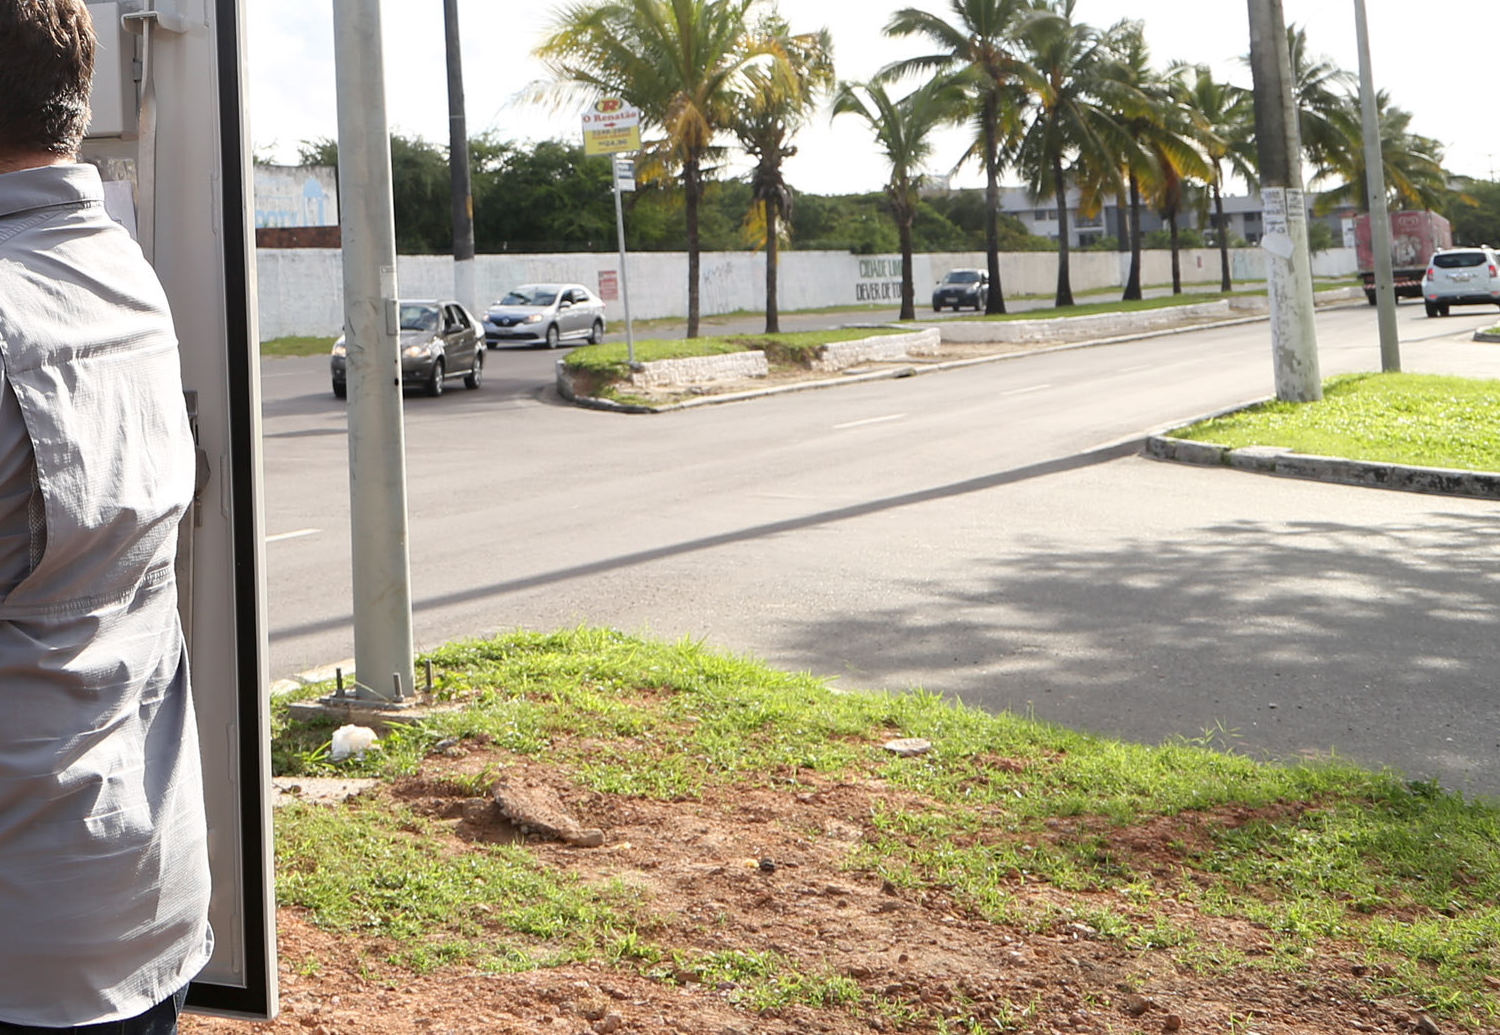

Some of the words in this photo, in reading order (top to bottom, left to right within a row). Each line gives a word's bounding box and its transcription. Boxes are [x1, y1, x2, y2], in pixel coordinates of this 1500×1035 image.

[860, 259, 887, 278] CIDADE
[889, 259, 903, 277] LIM
[856, 283, 881, 301] DEVER
[881, 281, 891, 299] DE
[892, 281, 903, 299] TO
